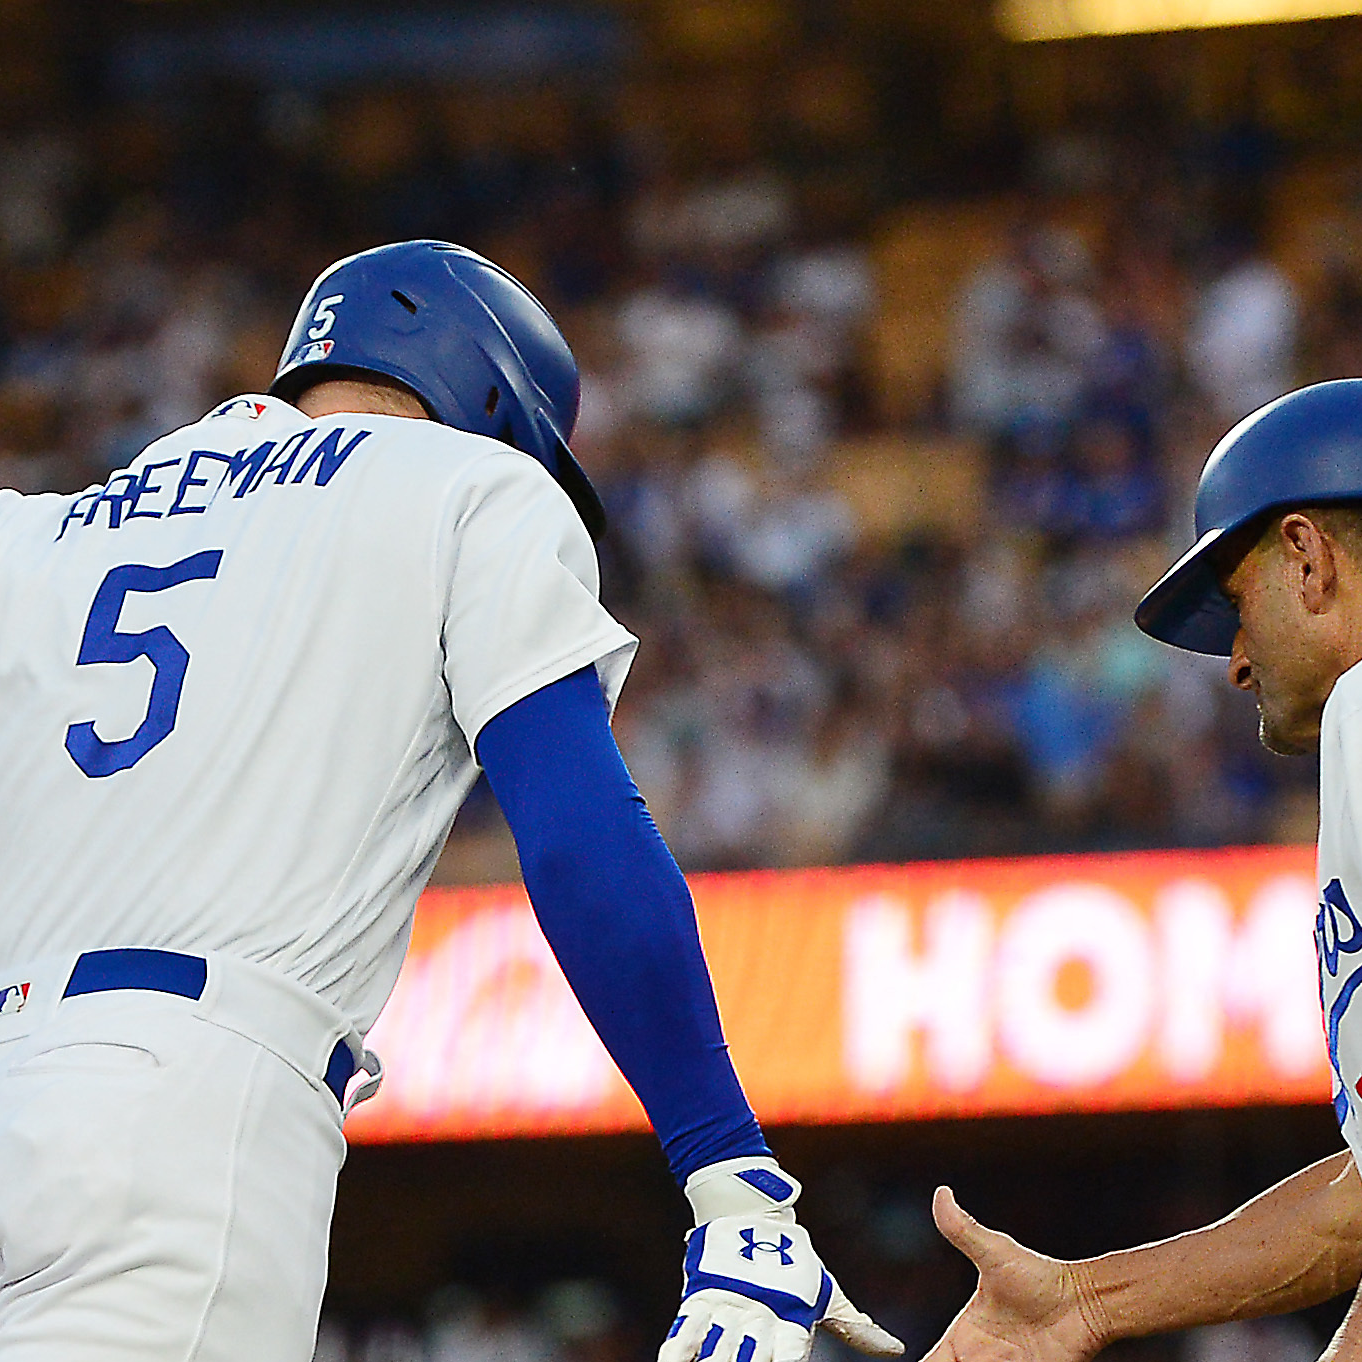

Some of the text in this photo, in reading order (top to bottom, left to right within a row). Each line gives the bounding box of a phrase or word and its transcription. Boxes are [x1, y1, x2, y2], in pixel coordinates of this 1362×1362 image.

[308, 294, 344, 339] 5
[54, 427, 372, 542] FREEMAN
[64, 550, 223, 778] 5
[846, 876, 1319, 1093] HOM
